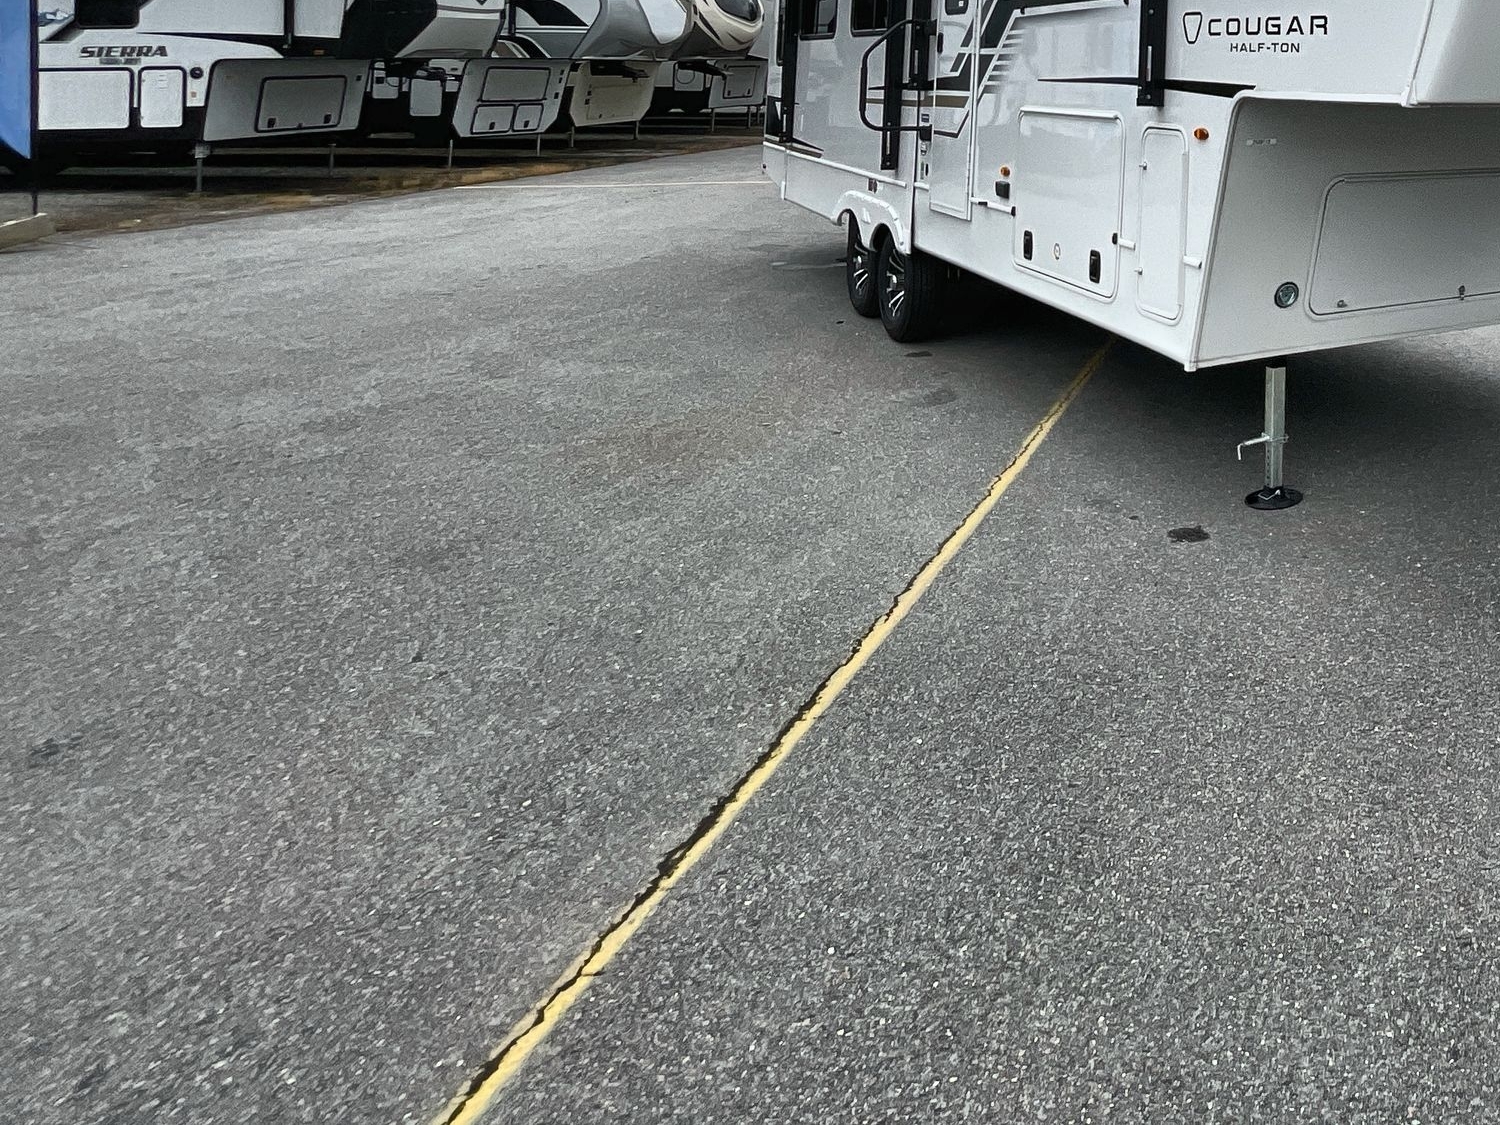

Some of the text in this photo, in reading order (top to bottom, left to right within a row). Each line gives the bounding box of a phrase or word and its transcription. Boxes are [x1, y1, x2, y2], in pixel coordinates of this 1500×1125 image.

[1208, 15, 1329, 36] COUGAR
[79, 45, 169, 58] SIERRA
[1230, 42, 1301, 53] HALF-TON
